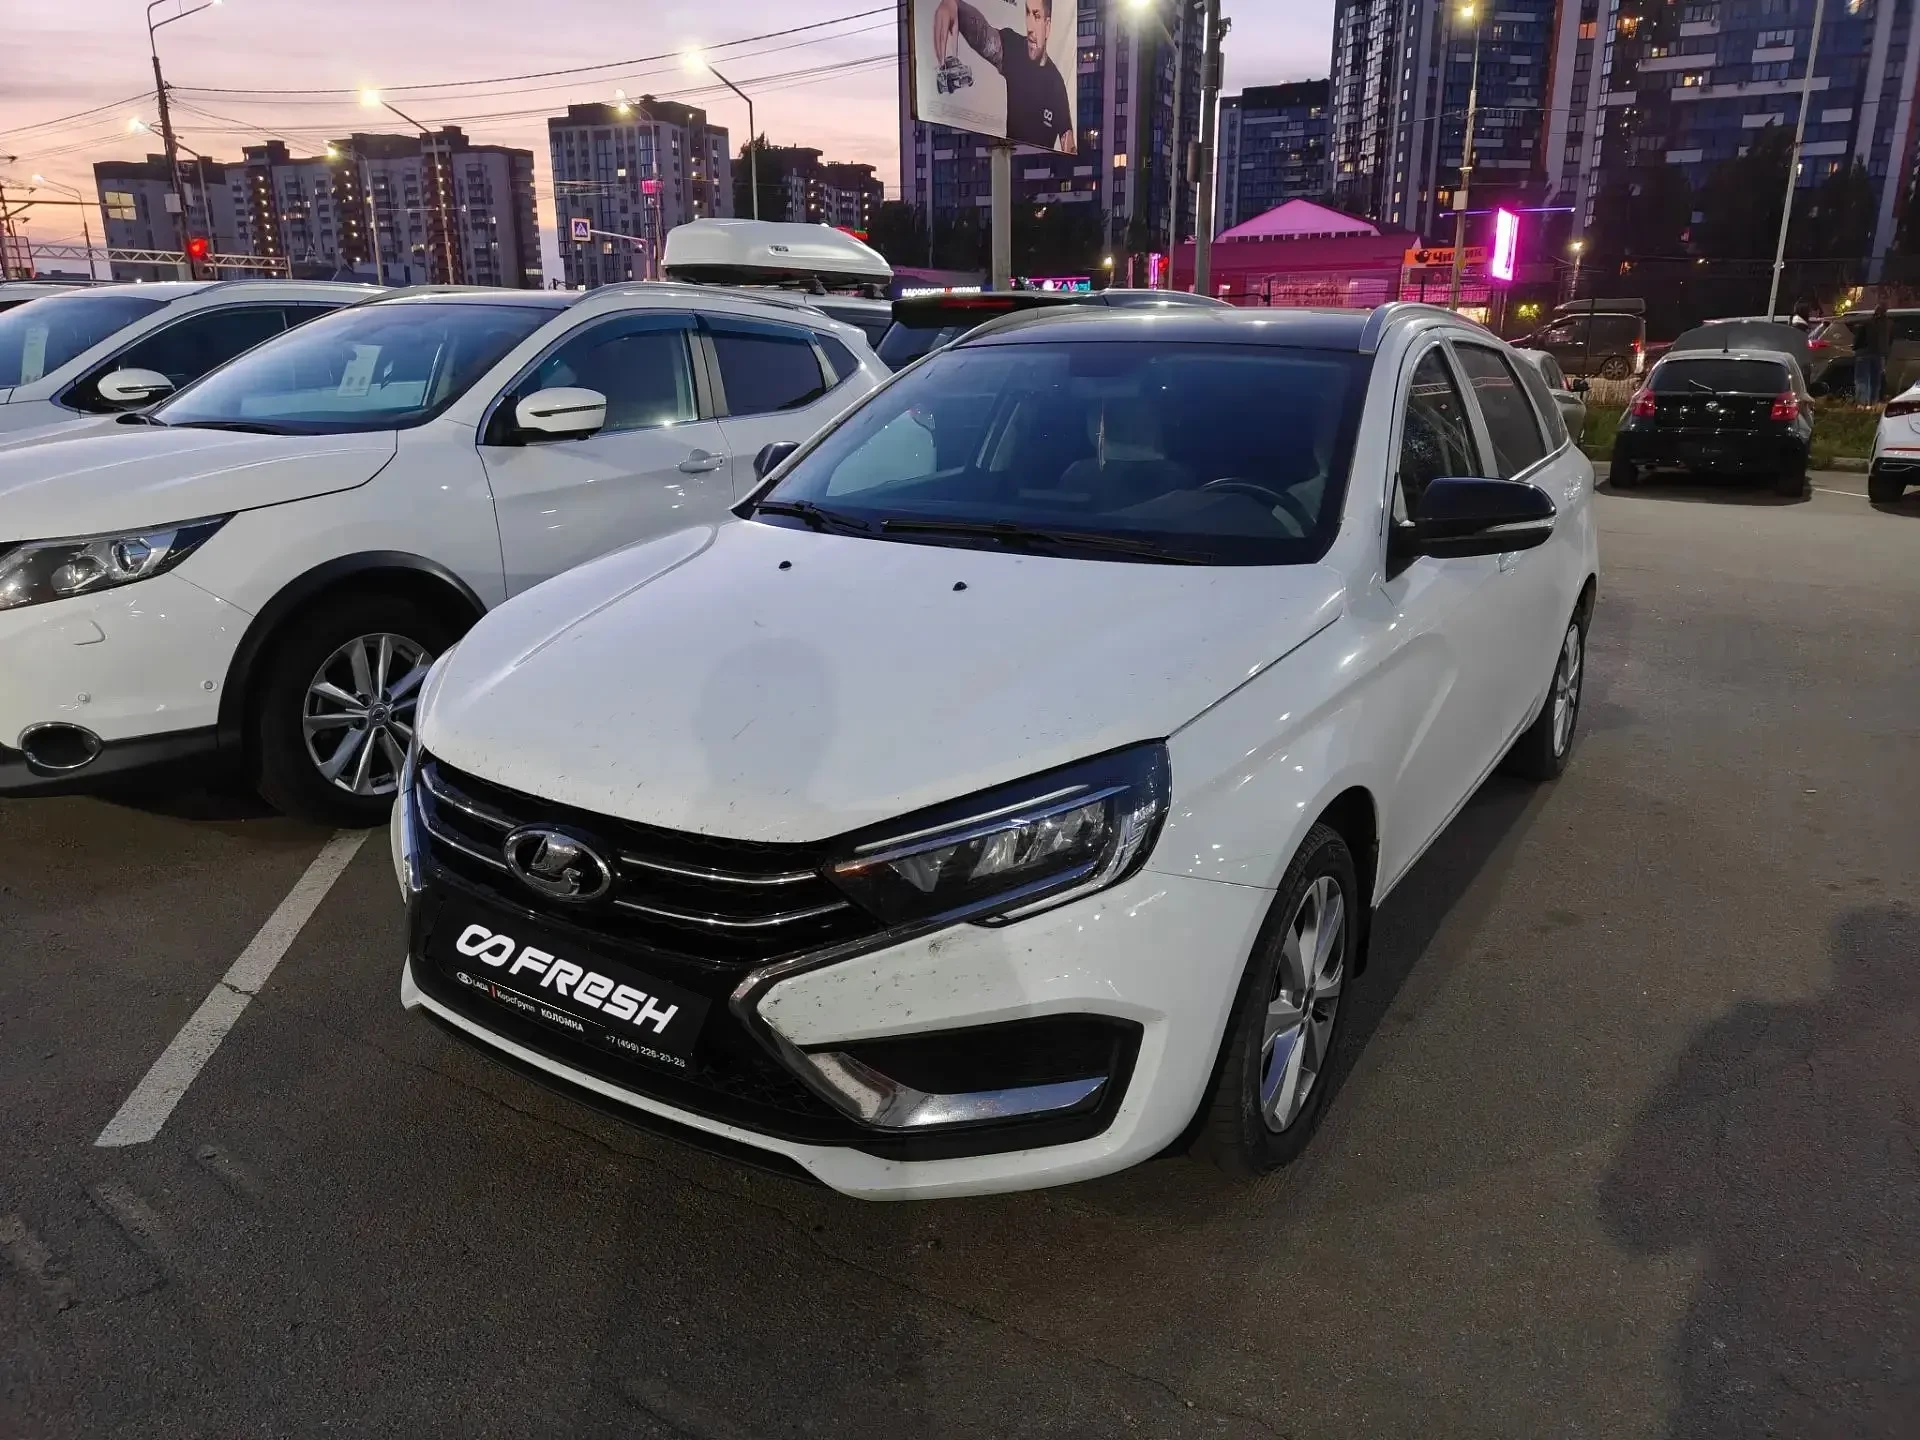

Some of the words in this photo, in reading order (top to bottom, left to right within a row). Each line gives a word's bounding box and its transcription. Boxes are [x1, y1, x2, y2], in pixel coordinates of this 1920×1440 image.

[472, 979, 489, 992] LADA
[541, 1008, 585, 1032] КОЛОМНА
[605, 1035, 615, 1044] +7
[617, 1038, 639, 1053] (499)
